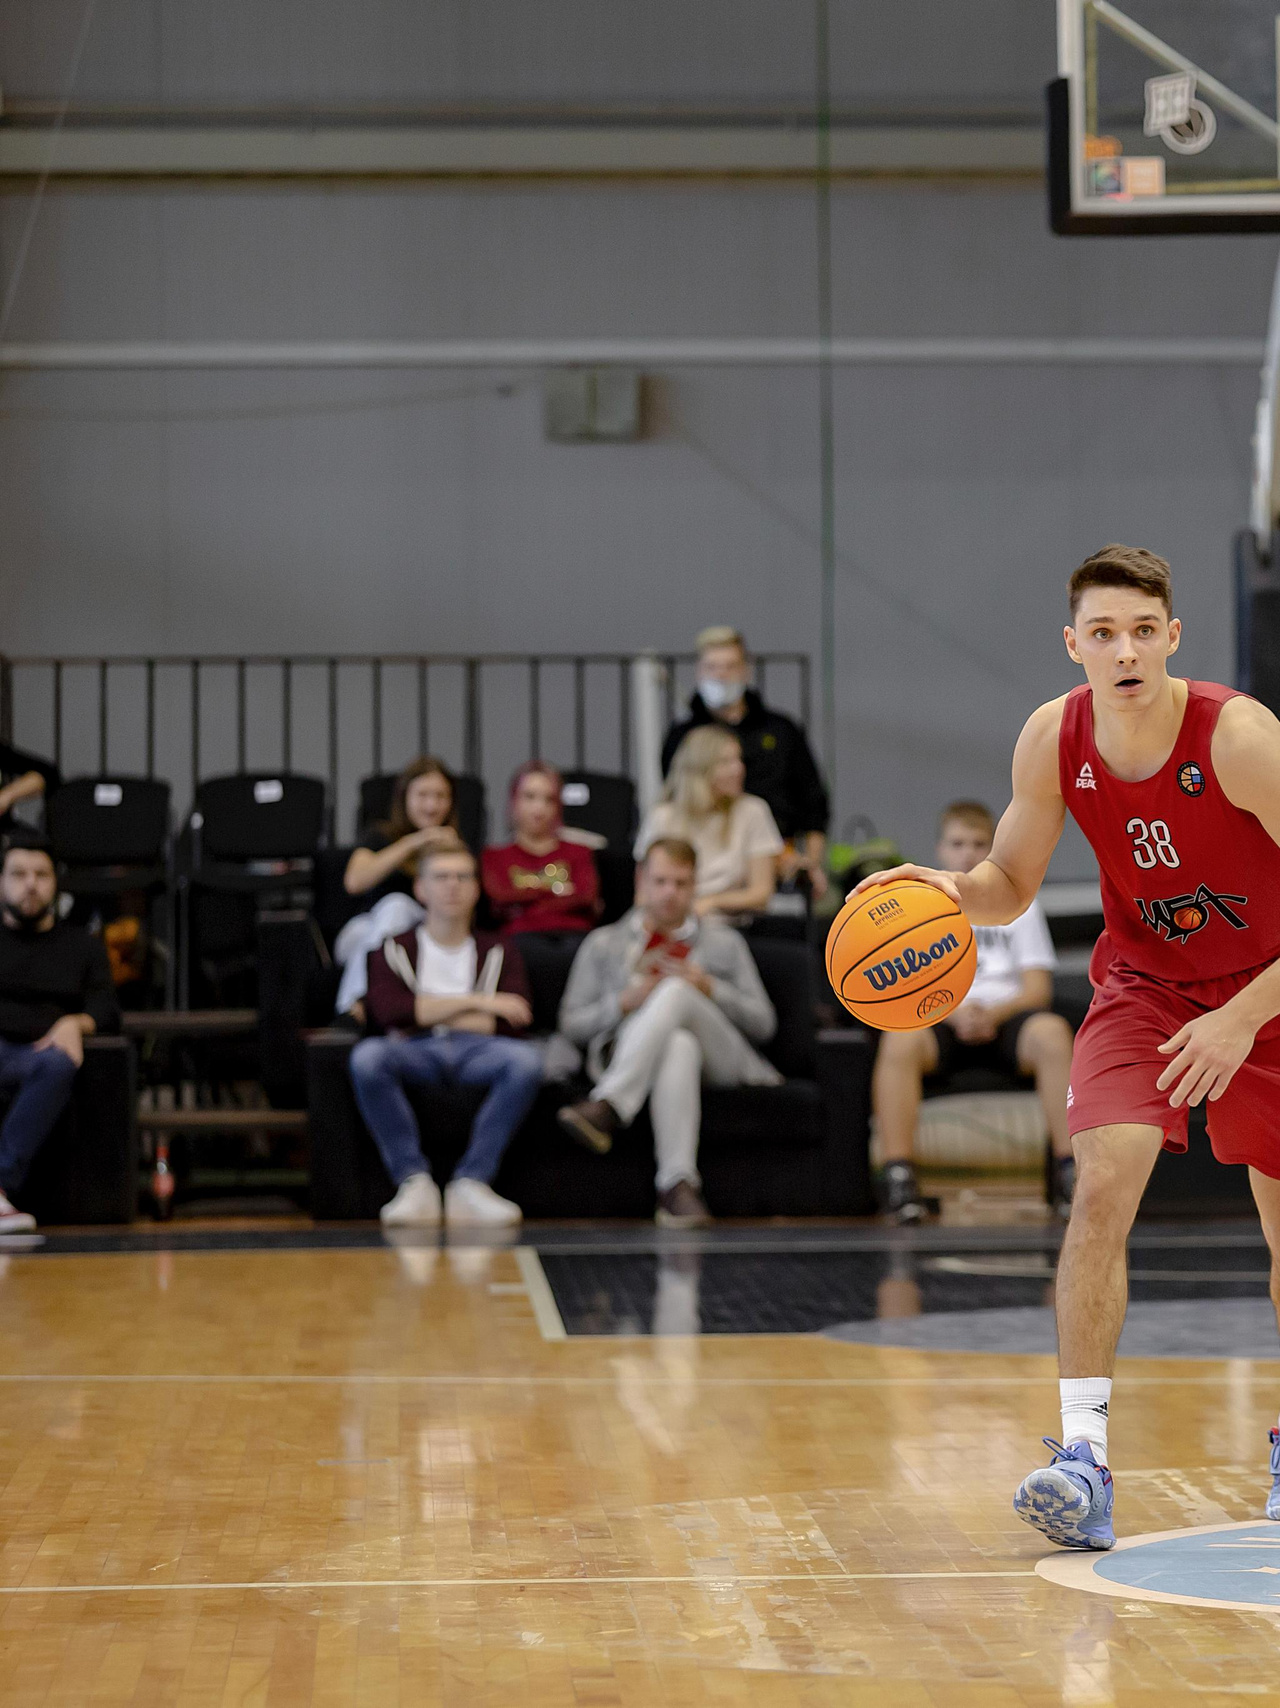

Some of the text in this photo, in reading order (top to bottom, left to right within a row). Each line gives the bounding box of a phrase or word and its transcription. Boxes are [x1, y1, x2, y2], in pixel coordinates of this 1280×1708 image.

[1075, 777, 1098, 791] PEAK
[1126, 816, 1181, 869] 38
[867, 898, 900, 921] FIBA
[863, 932, 960, 991] Wilson
